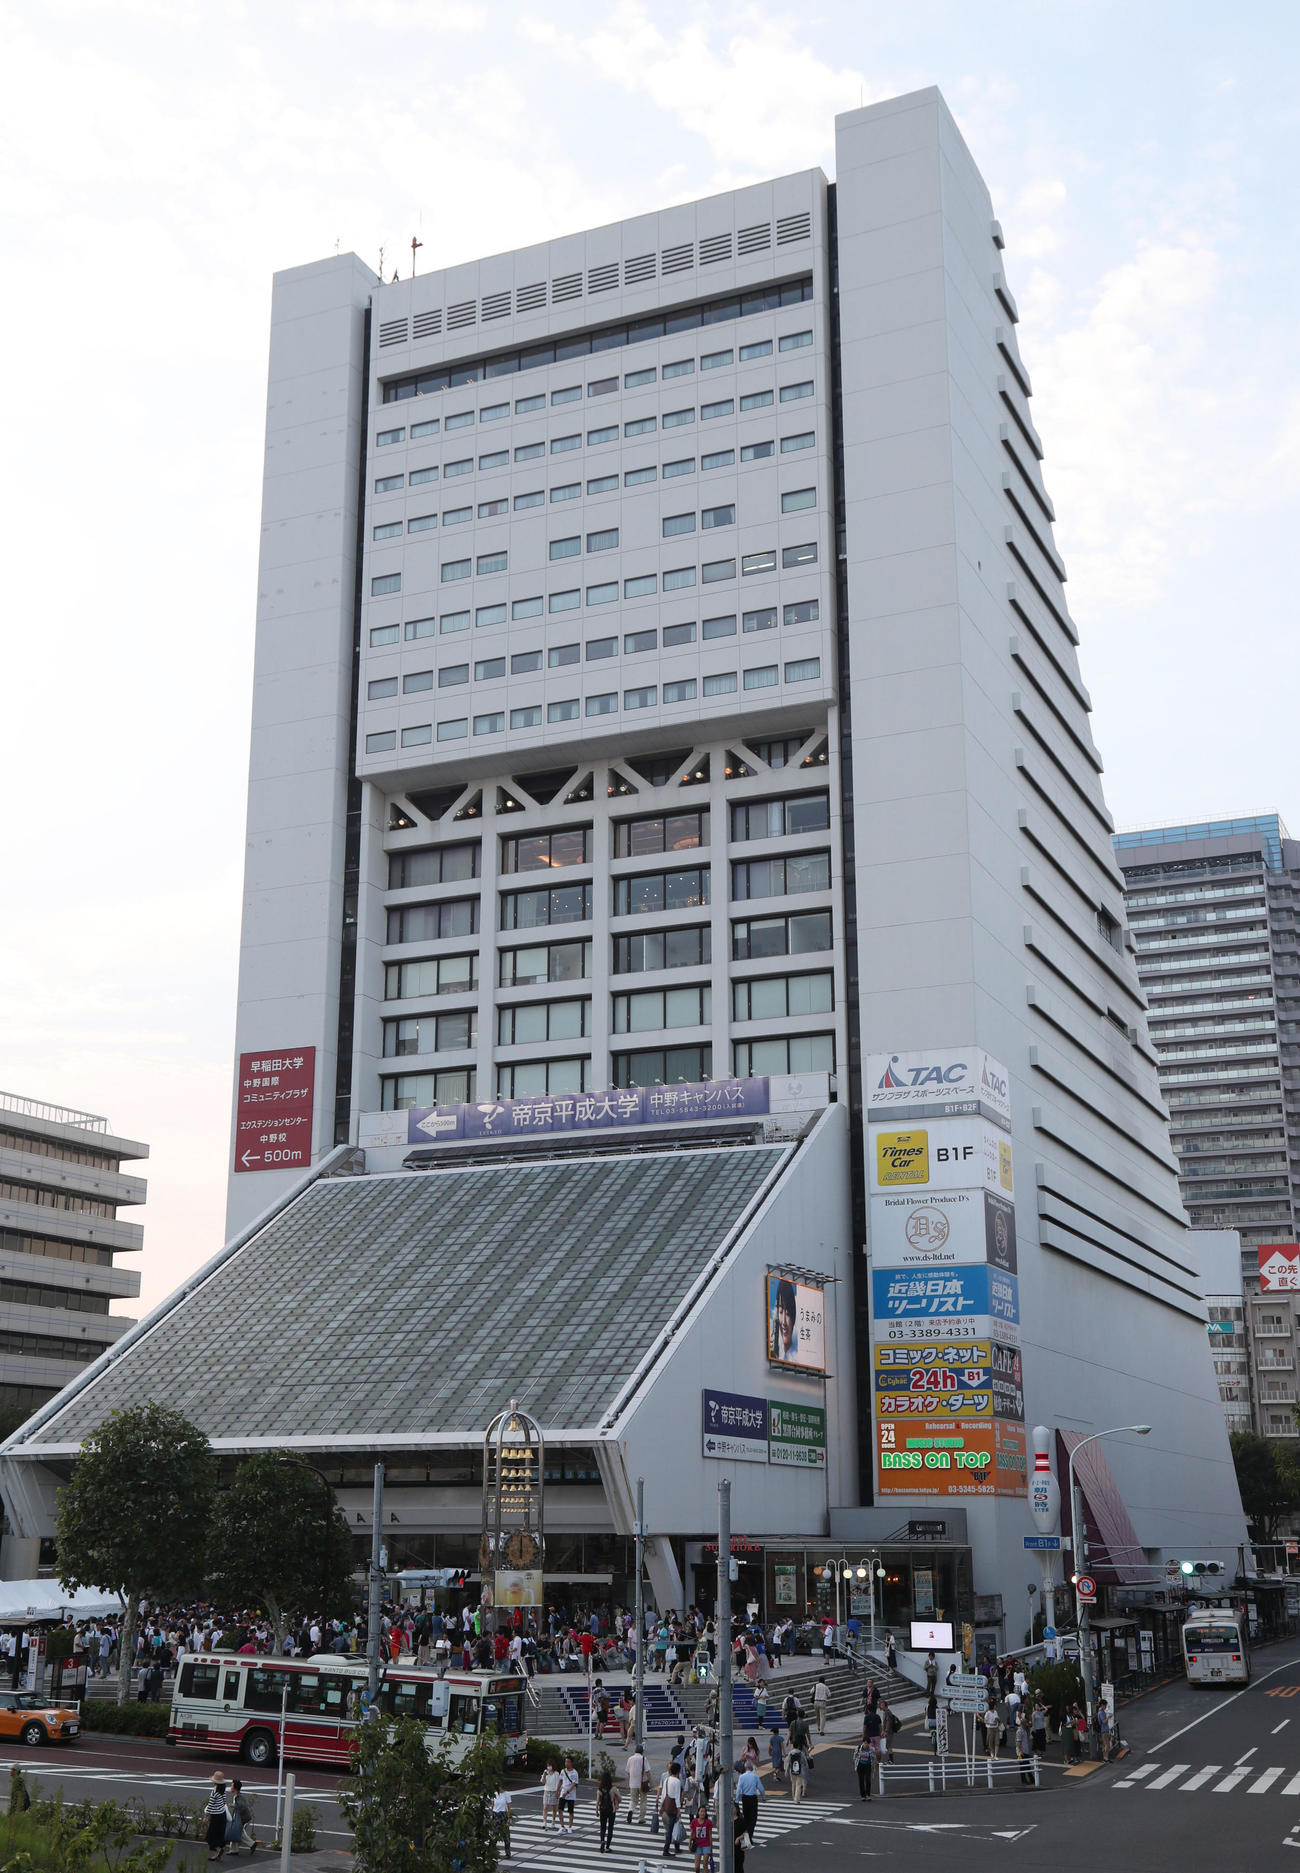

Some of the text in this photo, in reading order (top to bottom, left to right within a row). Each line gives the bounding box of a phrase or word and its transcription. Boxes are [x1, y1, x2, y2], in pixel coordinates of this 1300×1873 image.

[250, 1056, 304, 1073] 早稲田大学
[907, 1062, 968, 1086] TAC
[243, 1076, 280, 1089] 中野国際
[989, 1071, 1007, 1098] TAC
[243, 1087, 309, 1103] コミュニティプラザ
[649, 1085, 746, 1109] 中野キャンパス
[511, 1093, 640, 1127] 帝京平成大学
[240, 1116, 309, 1130] エクステンションセンター
[259, 1132, 287, 1144] 中野校
[263, 1148, 302, 1162] 500m
[882, 1146, 925, 1158] Times
[936, 1146, 974, 1162] B1F
[891, 1157, 915, 1168] Car
[885, 1199, 906, 1207] Bridal
[906, 1197, 928, 1206] Flower
[929, 1195, 957, 1204] Produce
[902, 1253, 956, 1263] www.ds-ltd.net
[1268, 1264, 1298, 1275] この先
[887, 1278, 964, 1298] 近畿日本
[1278, 1276, 1297, 1287] 直ぐ
[887, 1296, 975, 1315] ツーリスト
[888, 1327, 976, 1339] 03-3389-4331
[880, 1346, 987, 1365] コミック・ネット
[910, 1367, 958, 1392] 24h
[967, 1370, 981, 1381] B1
[881, 1393, 989, 1413] カラオケ・ダーツ
[720, 1404, 763, 1429] 帝京平成大学
[925, 1422, 956, 1430] Rehearsal
[961, 1421, 993, 1430] Recording
[881, 1430, 896, 1443] 24
[905, 1437, 965, 1449] MUSIC STUDIO
[716, 1440, 746, 1455] 中野キャンパス
[880, 1451, 991, 1470] BASS ON TOP
[948, 1485, 995, 1494] 03-5345-5825
[67, 1658, 74, 1668] 3
